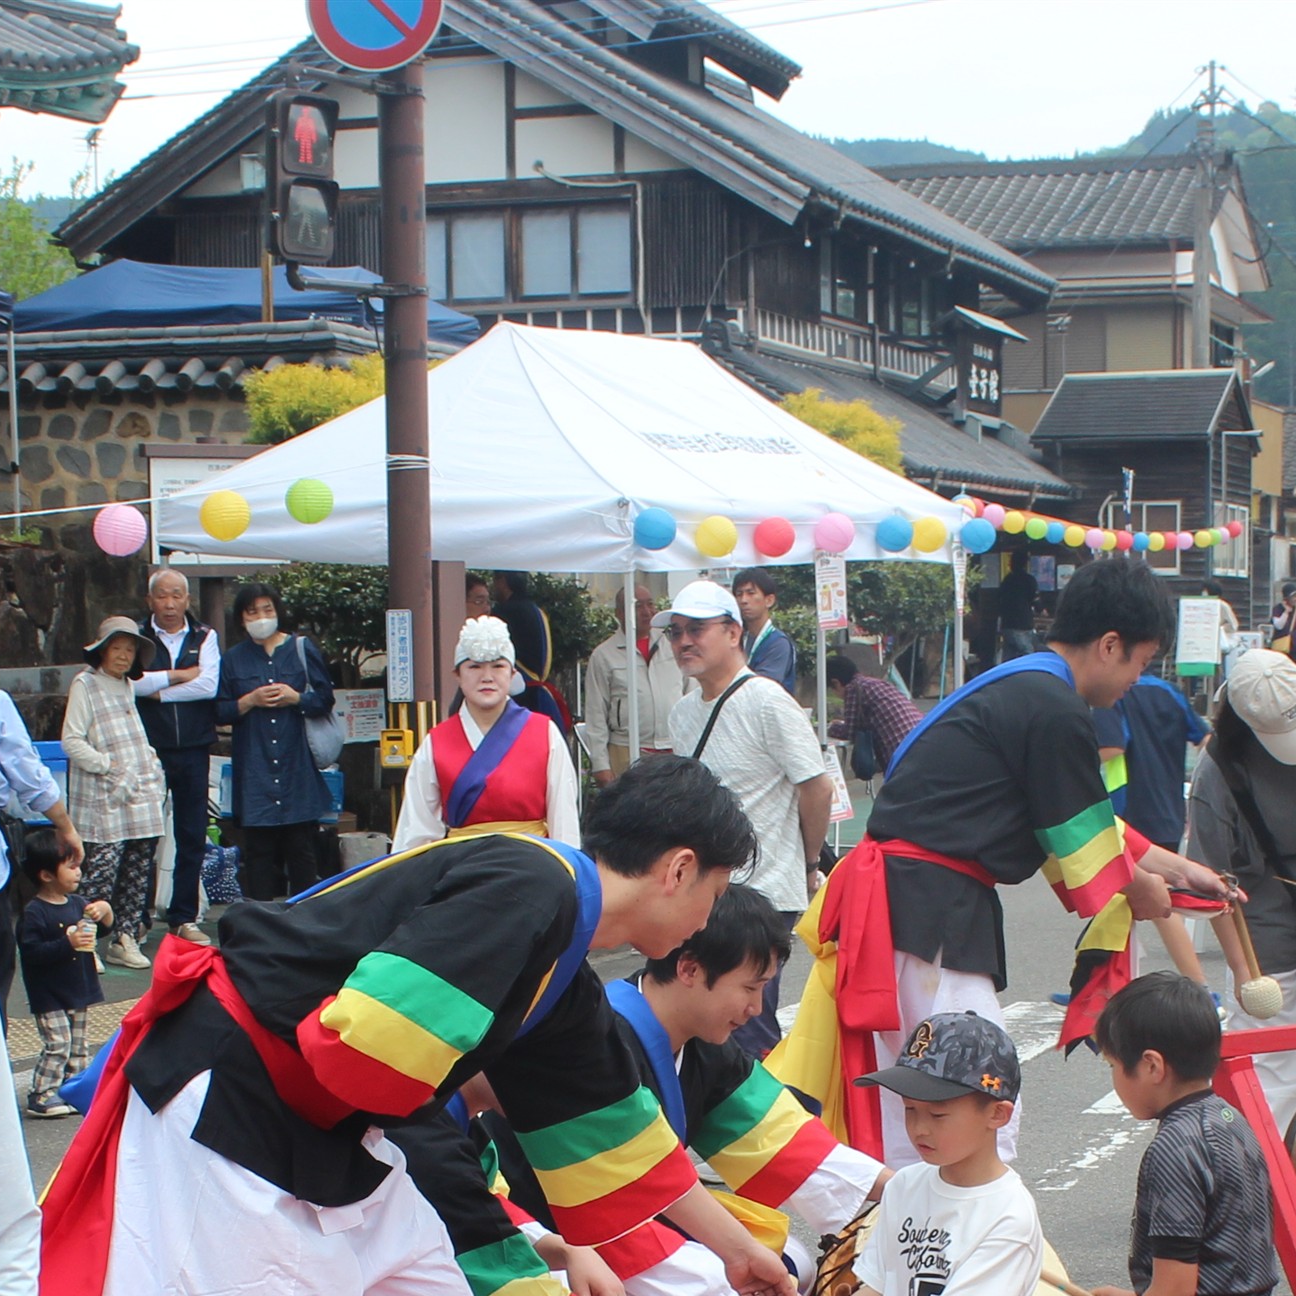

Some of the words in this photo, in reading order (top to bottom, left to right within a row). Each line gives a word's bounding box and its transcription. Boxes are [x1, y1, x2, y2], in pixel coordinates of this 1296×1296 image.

[397, 615, 409, 696] 歩行者用押ボタン
[907, 1021, 933, 1059] G
